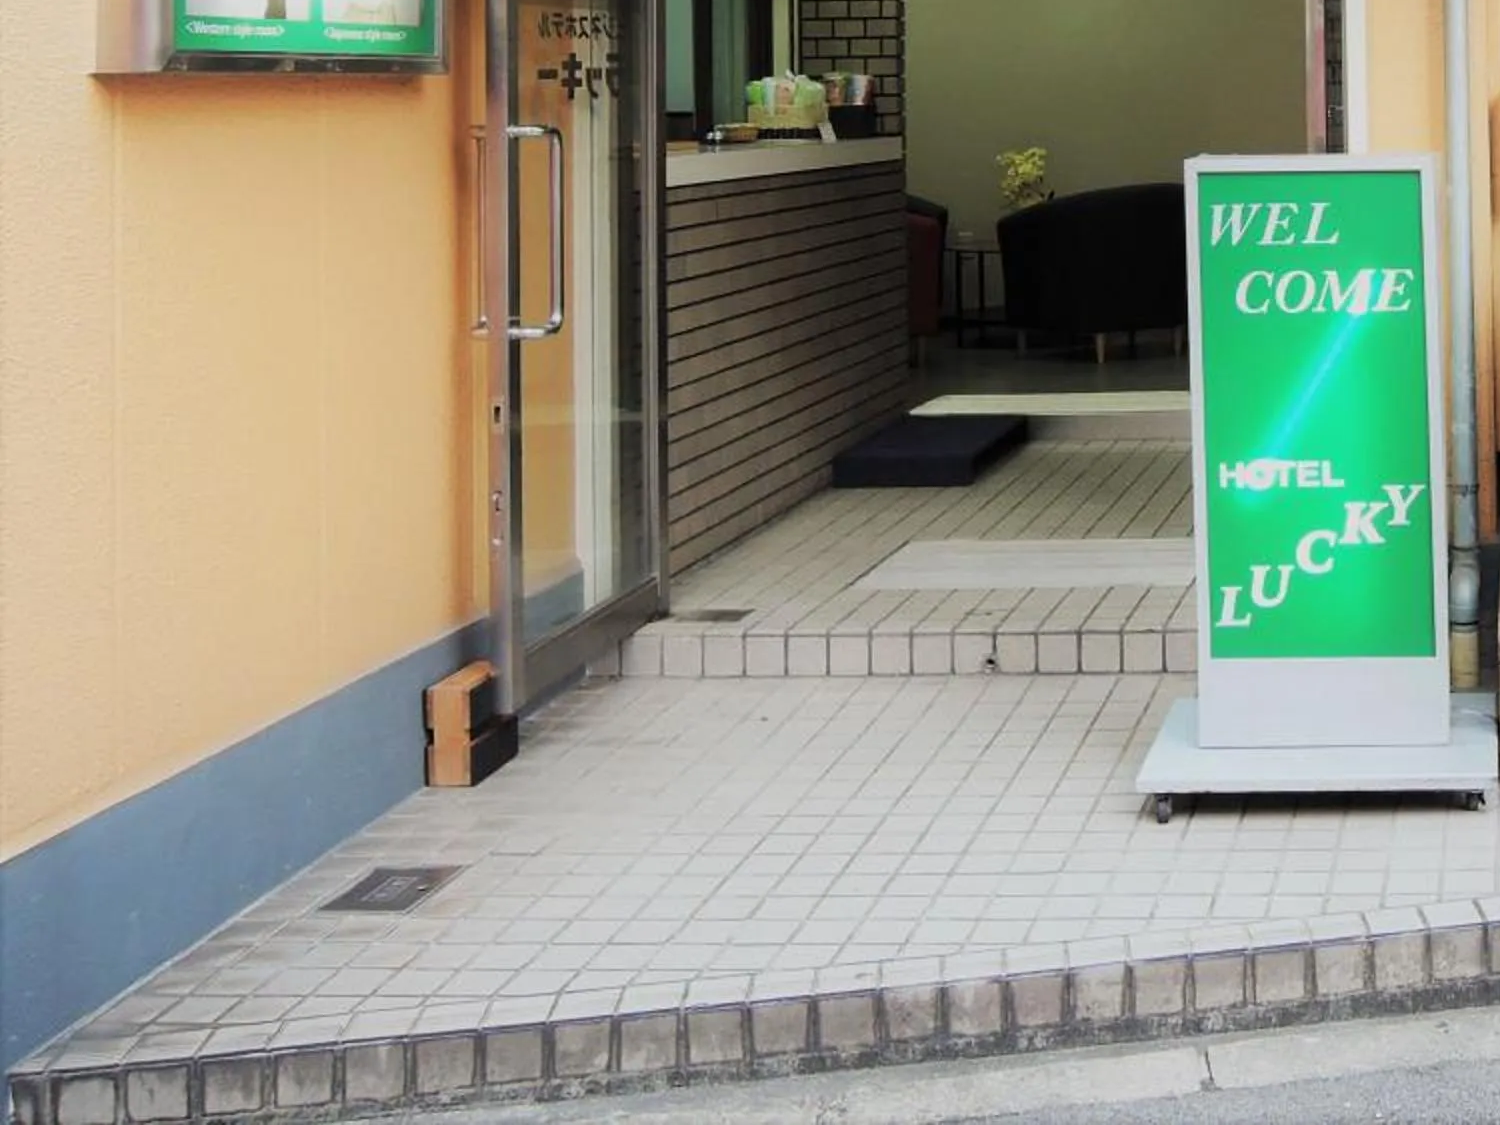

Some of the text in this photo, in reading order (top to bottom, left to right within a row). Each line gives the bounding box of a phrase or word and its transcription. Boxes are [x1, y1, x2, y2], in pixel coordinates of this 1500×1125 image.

[1208, 202, 1341, 247] WEL
[1234, 267, 1416, 316] COME
[1218, 457, 1346, 491] HOTEL
[1214, 483, 1427, 628] LUCKY
